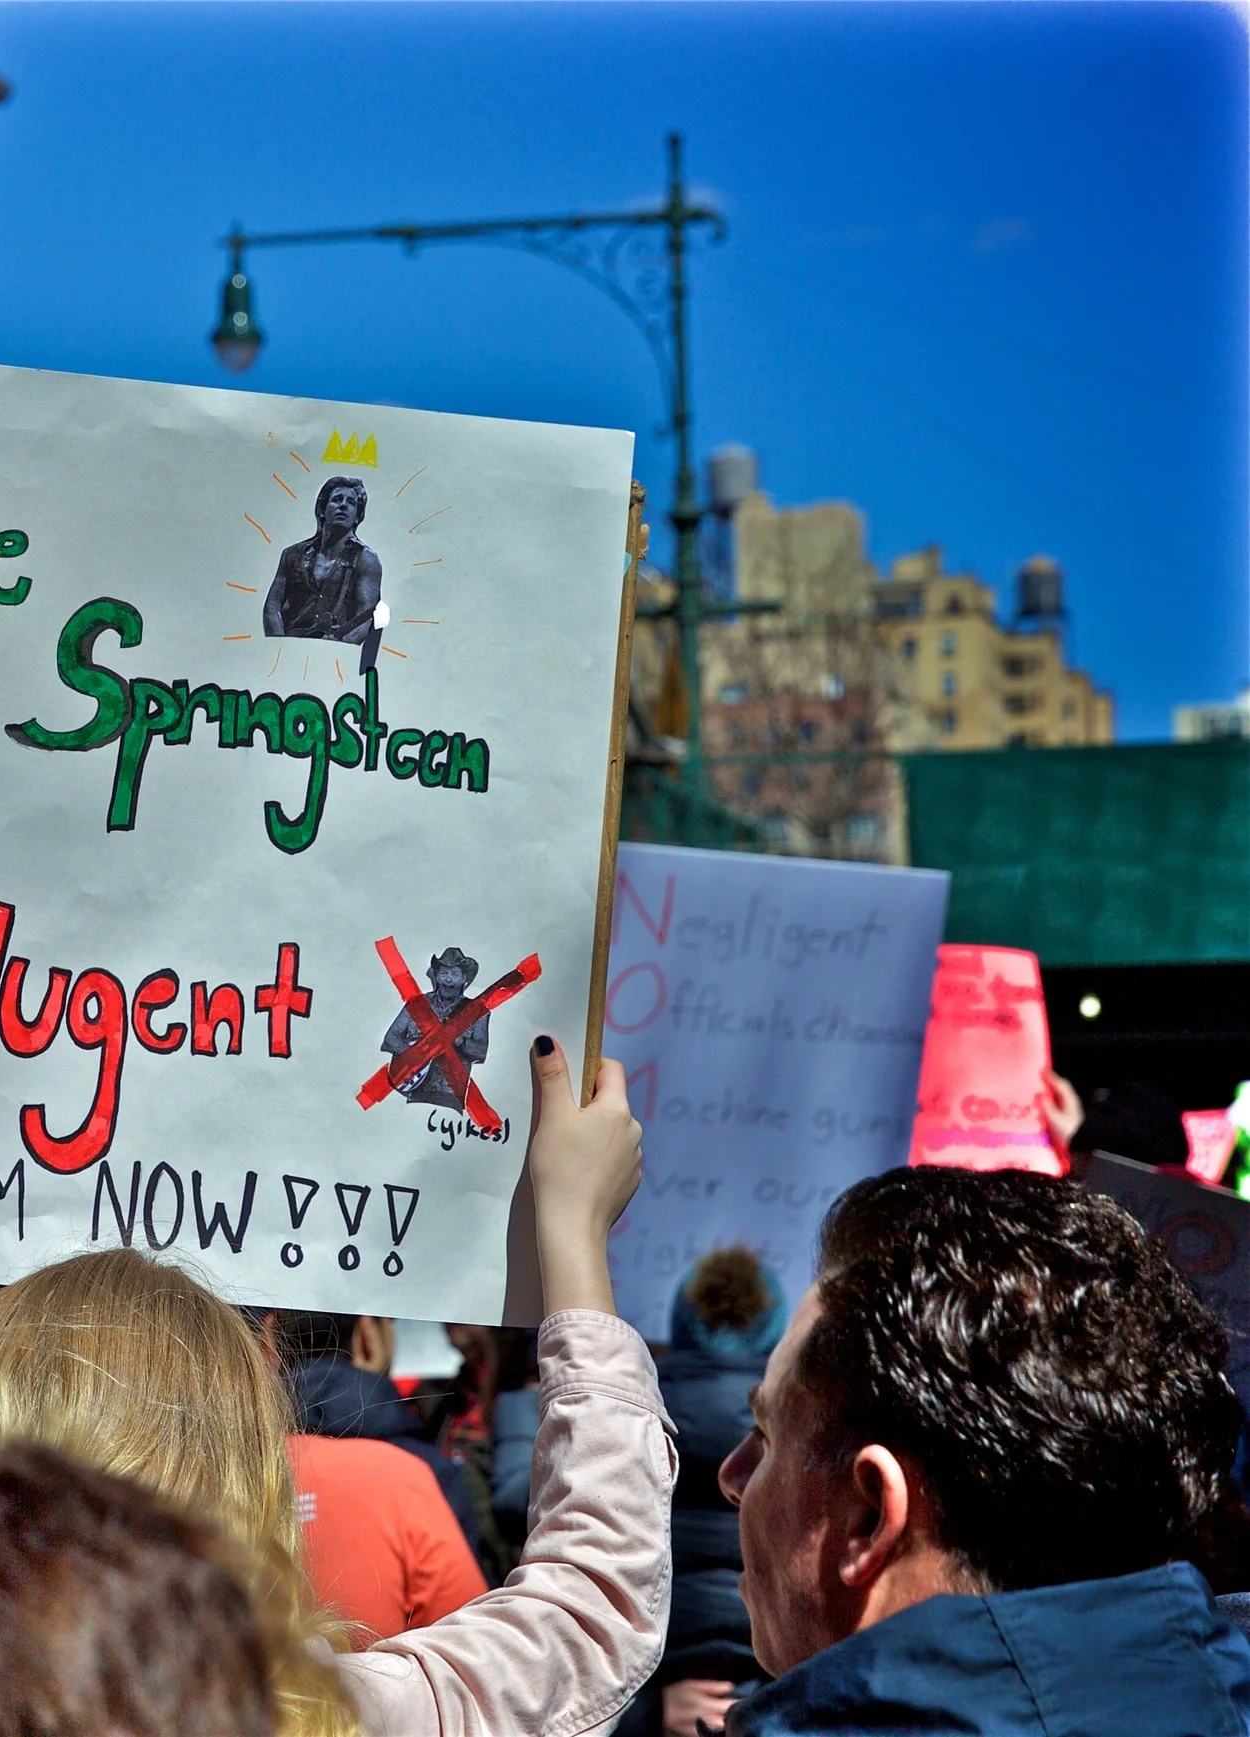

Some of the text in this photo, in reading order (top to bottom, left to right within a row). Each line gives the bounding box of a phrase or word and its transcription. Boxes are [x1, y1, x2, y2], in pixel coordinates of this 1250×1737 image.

[5, 597, 490, 855] Springsteen
[611, 873, 889, 970] Negligent
[427, 1109, 510, 1151] (yikes)
[644, 1164, 724, 1200] ver
